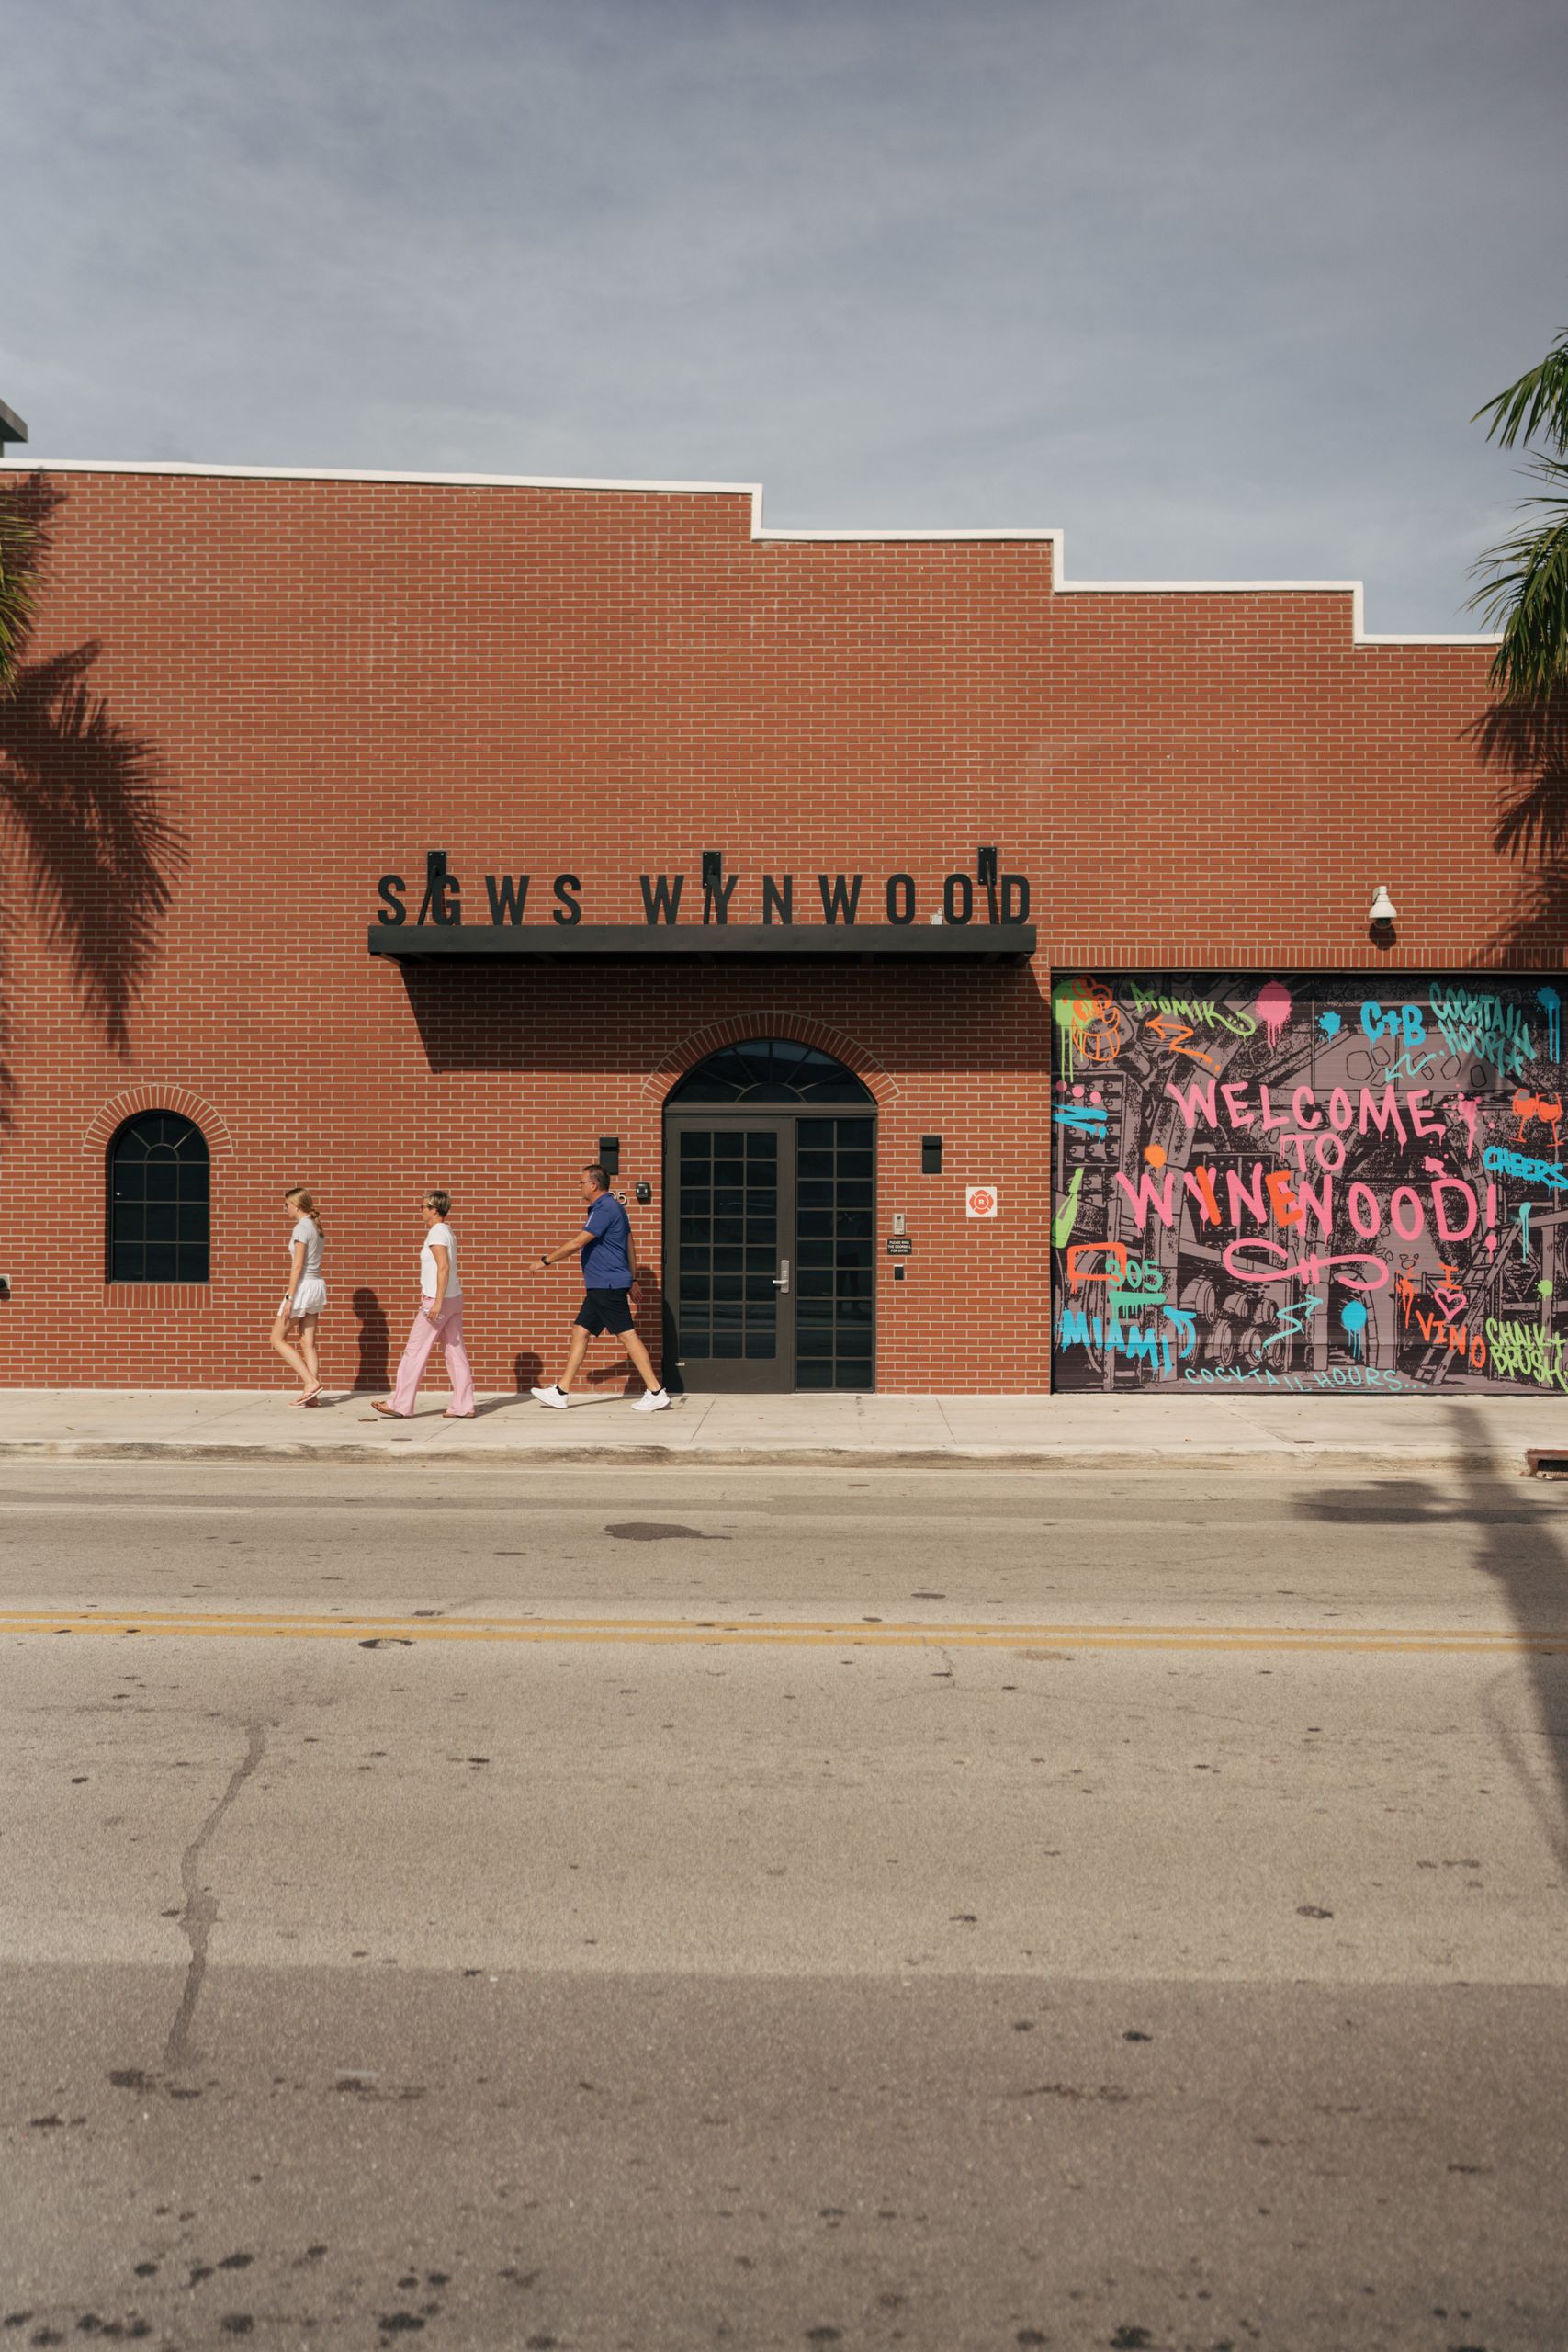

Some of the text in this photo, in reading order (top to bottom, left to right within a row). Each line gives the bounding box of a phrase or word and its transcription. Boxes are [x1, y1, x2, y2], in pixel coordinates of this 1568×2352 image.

[378, 874, 1030, 926] SGWS WYNWOOD
[1167, 1079, 1447, 1139] WELCOME
[1280, 1133, 1346, 1173] TO
[1106, 1260, 1163, 1292] 305
[1062, 1308, 1173, 1376] MIAMI
[1416, 1310, 1486, 1367] VINO
[1184, 1366, 1312, 1392] COCKTAIL
